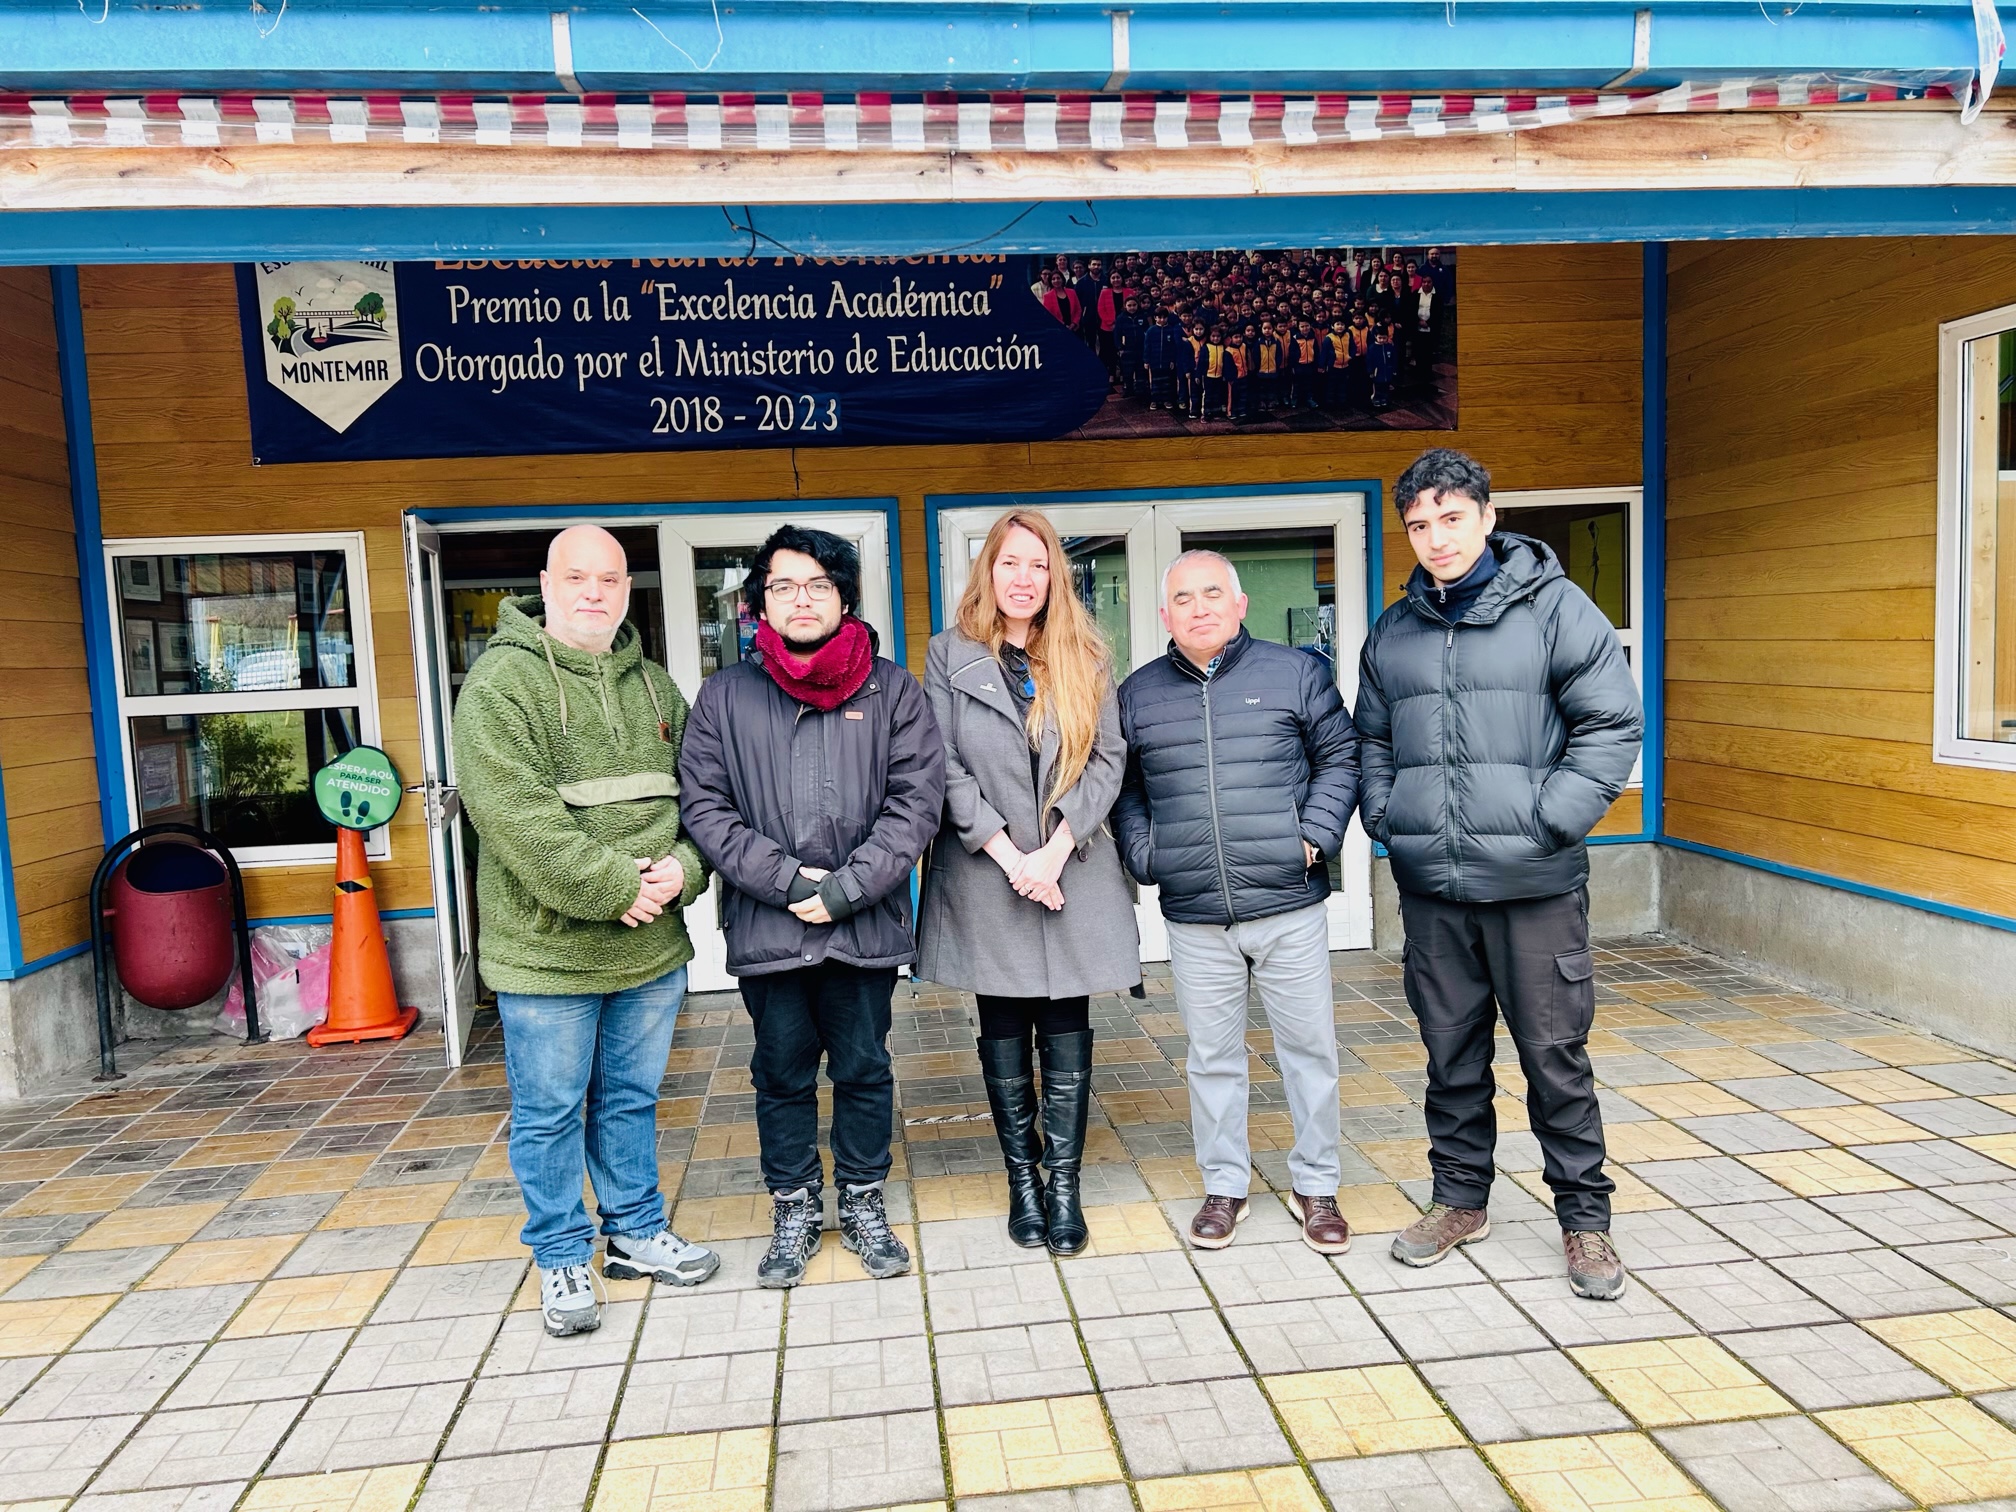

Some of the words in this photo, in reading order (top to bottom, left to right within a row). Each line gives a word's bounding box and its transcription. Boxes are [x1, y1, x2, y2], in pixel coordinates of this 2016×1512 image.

[446, 285, 561, 324] Premio
[573, 296, 593, 322] a
[599, 280, 632, 322] la
[641, 279, 817, 321] “Excelencia
[826, 274, 1003, 319] Académica”
[281, 360, 389, 385] MONTEMAR
[415, 337, 565, 394] Otorgado
[574, 352, 628, 392] por
[639, 335, 664, 377] el
[675, 337, 835, 377] Ministerio
[846, 332, 879, 374] de
[887, 331, 1042, 373] Educación
[650, 396, 724, 433] 2018
[756, 394, 838, 431] 2023
[326, 778, 390, 796] ATENDIDO
[340, 772, 363, 782] PARA
[364, 777, 381, 785] SER
